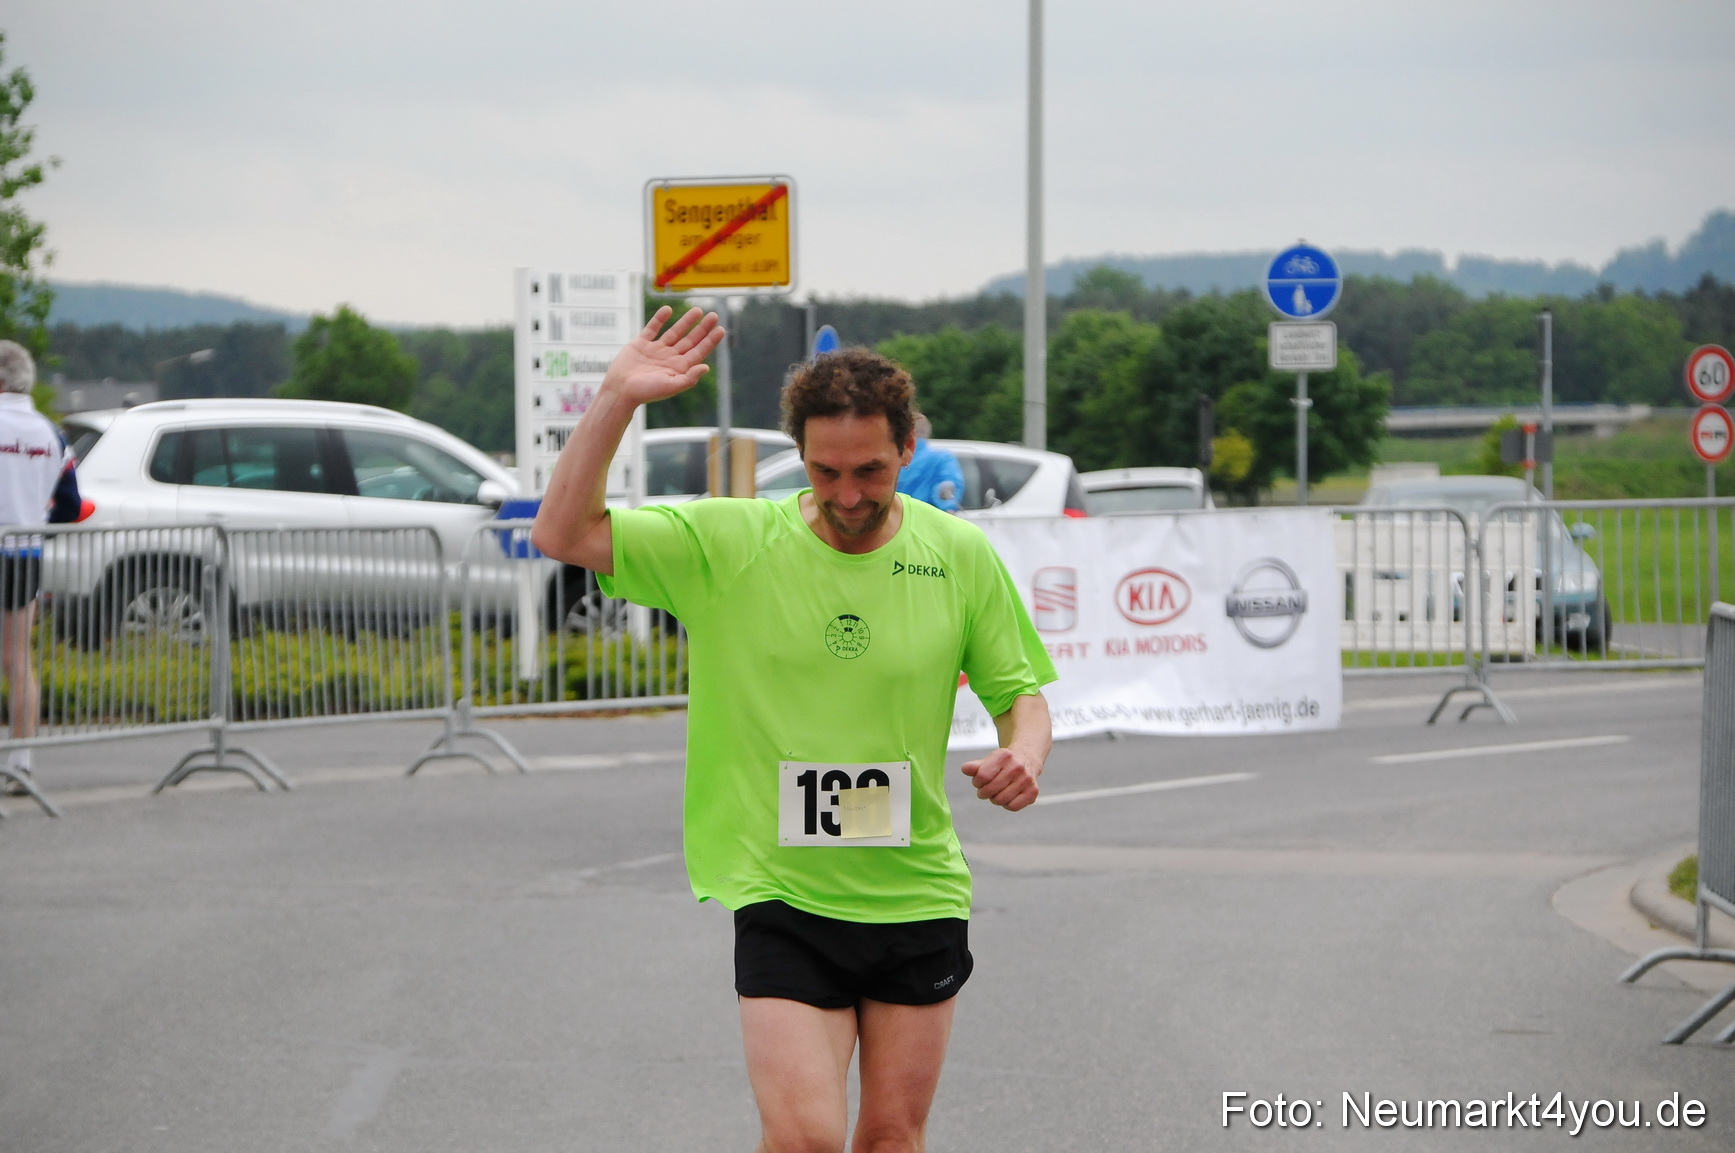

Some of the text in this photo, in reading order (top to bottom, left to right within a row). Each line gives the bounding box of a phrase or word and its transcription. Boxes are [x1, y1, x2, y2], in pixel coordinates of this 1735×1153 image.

[1700, 360, 1726, 386] 60
[907, 563, 946, 579] DEKRA
[1128, 581, 1177, 612] KIA
[1234, 595, 1300, 612] NISSAN
[1104, 632, 1208, 657] KIA MOTORS
[797, 768, 890, 837] 13
[933, 975, 955, 990] CRAFT
